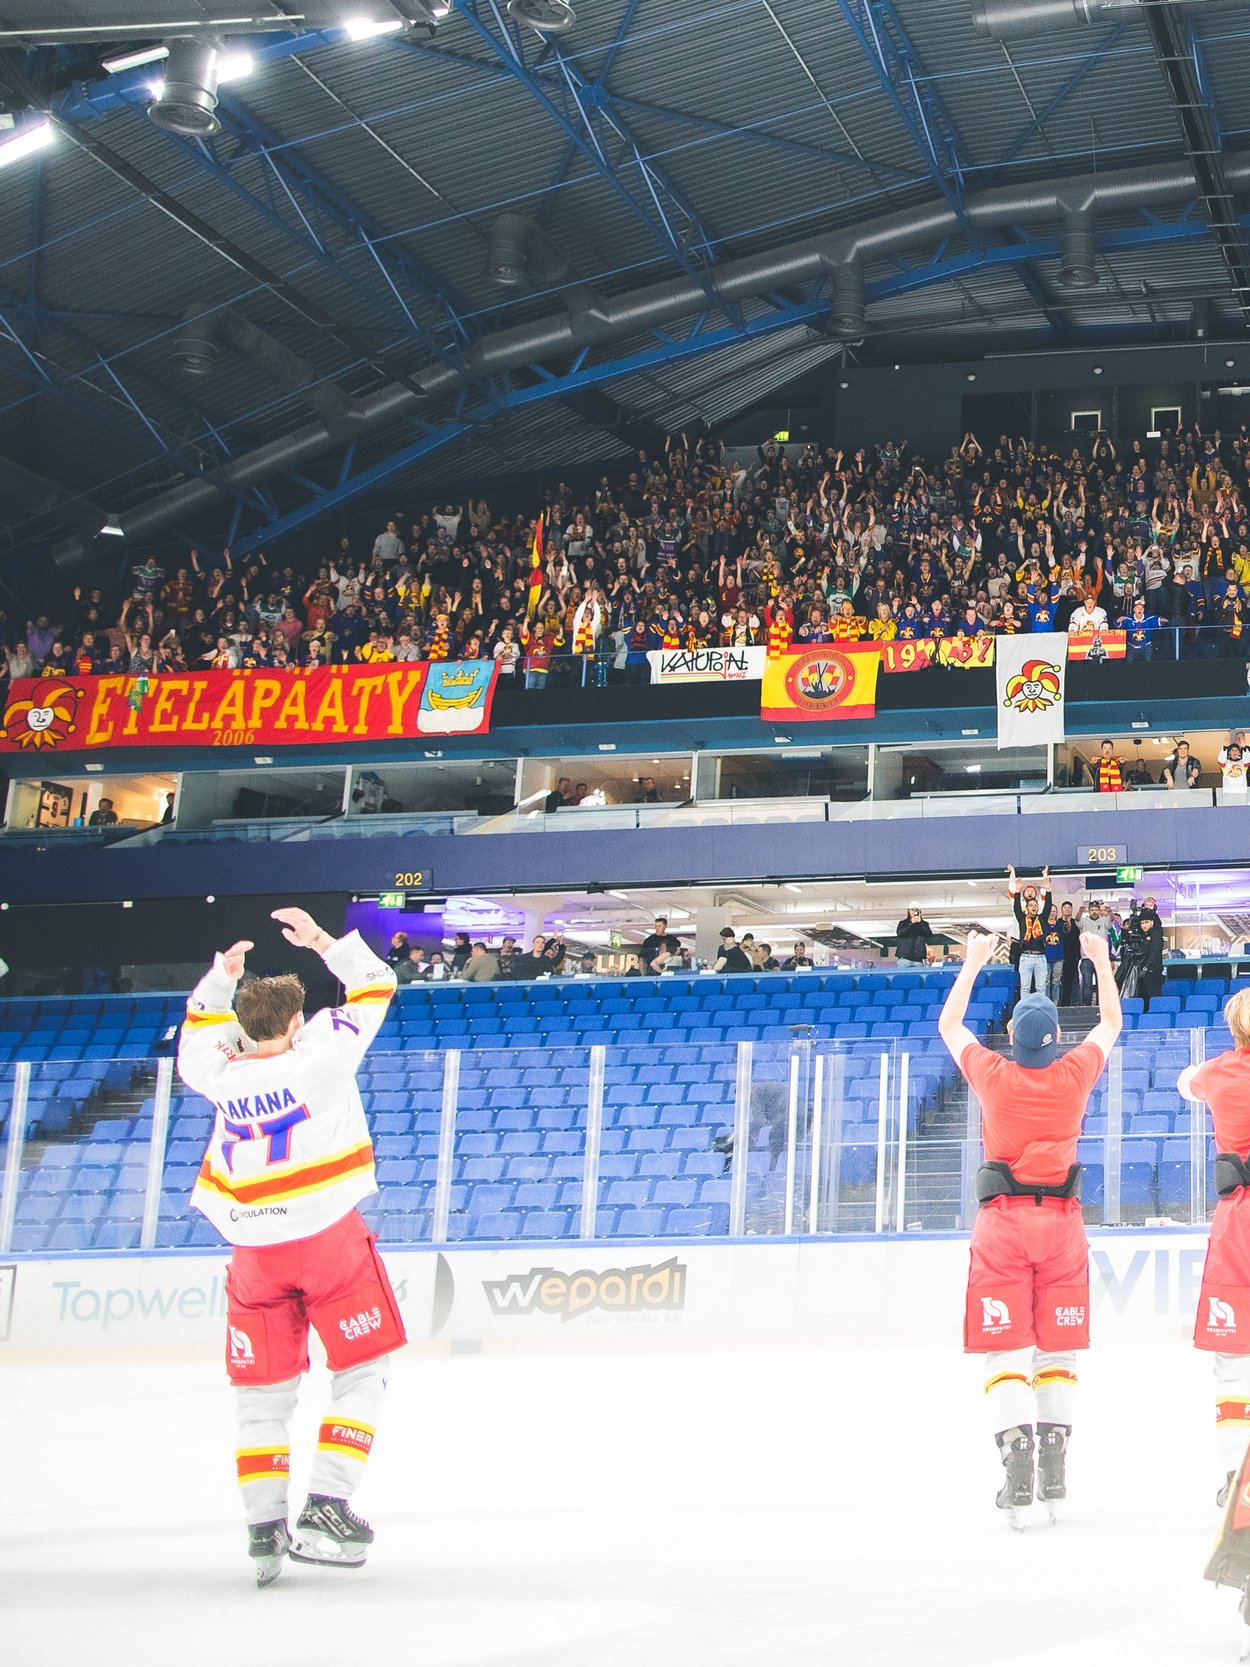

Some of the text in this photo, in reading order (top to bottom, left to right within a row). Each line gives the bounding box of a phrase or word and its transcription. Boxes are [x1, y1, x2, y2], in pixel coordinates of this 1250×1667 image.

[886, 644, 916, 670] 19
[84, 663, 422, 745] ETELÄPÄÄTY
[211, 728, 255, 747] 2006
[1088, 847, 1117, 862] 203
[394, 872, 422, 887] 202
[489, 1265, 682, 1314] wepardi
[339, 1307, 381, 1332] CABLE
[1055, 1306, 1085, 1317] CABLE
[1056, 1315, 1085, 1327] CREW
[344, 1317, 383, 1341] CREW
[331, 1425, 374, 1446] FINER
[321, 1504, 354, 1537] CCM
